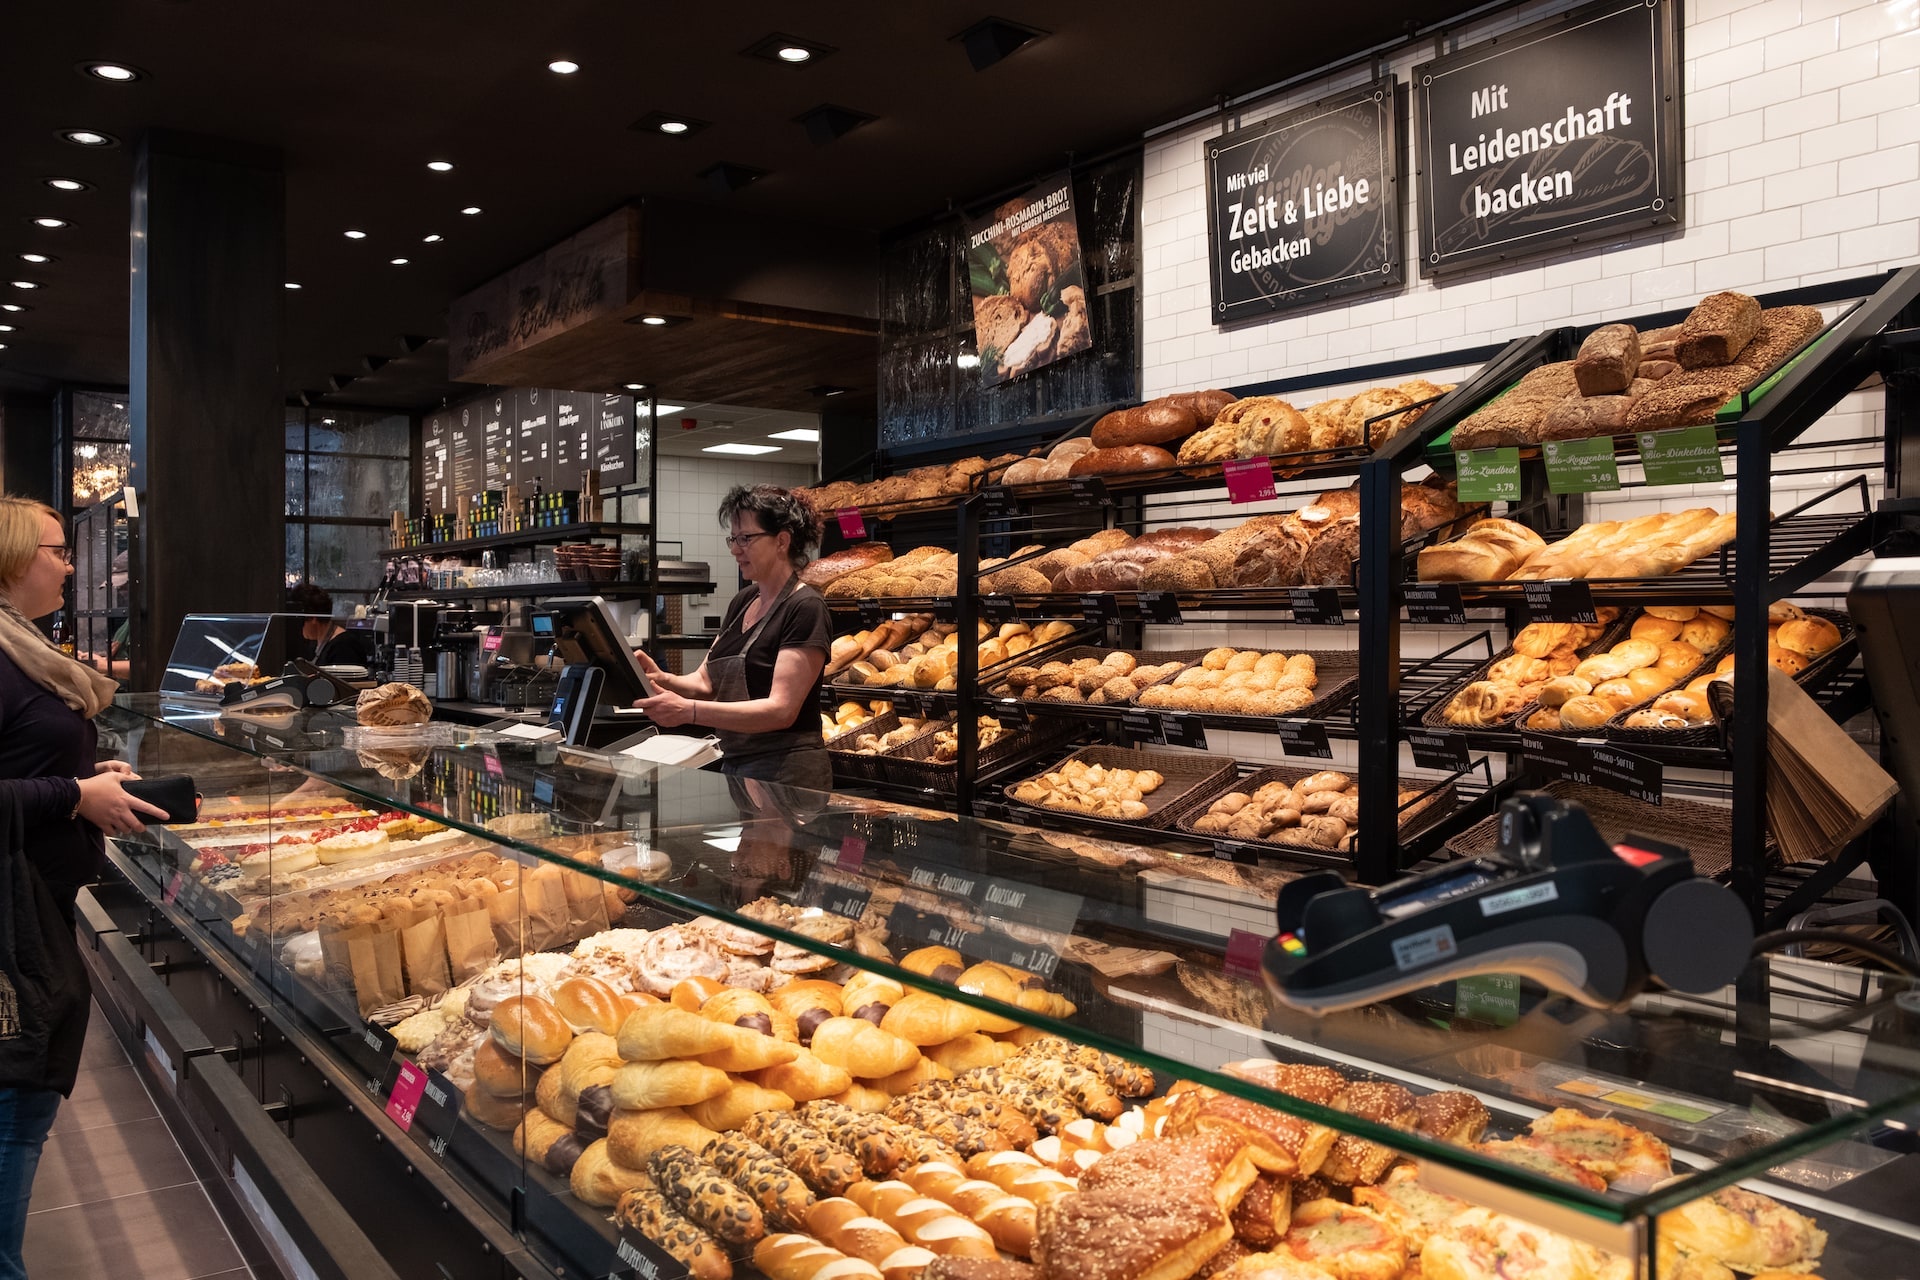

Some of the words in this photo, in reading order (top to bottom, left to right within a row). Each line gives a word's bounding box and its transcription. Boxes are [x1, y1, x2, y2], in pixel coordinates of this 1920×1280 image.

[1472, 84, 1508, 119] Mit
[1450, 92, 1631, 175] Leidenschaft
[1227, 173, 1247, 193] Mit
[1248, 163, 1269, 185] viel
[1475, 170, 1573, 218] backen
[970, 186, 1068, 249] ZUCCHINI-ROSMARIN-BROT
[1229, 195, 1279, 241] Zeit
[1284, 200, 1297, 225] &
[1303, 175, 1370, 219] Liebe
[1011, 229, 1021, 238] MIT
[1021, 214, 1043, 232] GROBEM
[1042, 200, 1070, 222] MEERSALZ
[1230, 237, 1311, 274] Gebacken
[1548, 453, 1614, 466] Bio-Roggenbrot
[1644, 446, 1717, 460] Bio-Dinkelbrot
[1460, 465, 1518, 478] Bio-Landbrot
[1591, 473, 1611, 483] 3,49
[1696, 466, 1717, 476] 4,25
[1496, 483, 1514, 492] 3,79
[1523, 582, 1552, 592] STEINOFEN
[1526, 593, 1552, 602] BAGUETTE
[1522, 737, 1544, 750] HEDWIG
[1592, 749, 1635, 771] SCHOKO-SOFTIE
[1573, 771, 1586, 784] 0,70
[1586, 774, 1592, 785] €
[1655, 794, 1660, 805] €
[909, 866, 935, 886] SCHOKO
[938, 873, 975, 896] CROISSANT
[985, 884, 1026, 908] CROISSANT
[1045, 955, 1055, 974] €
